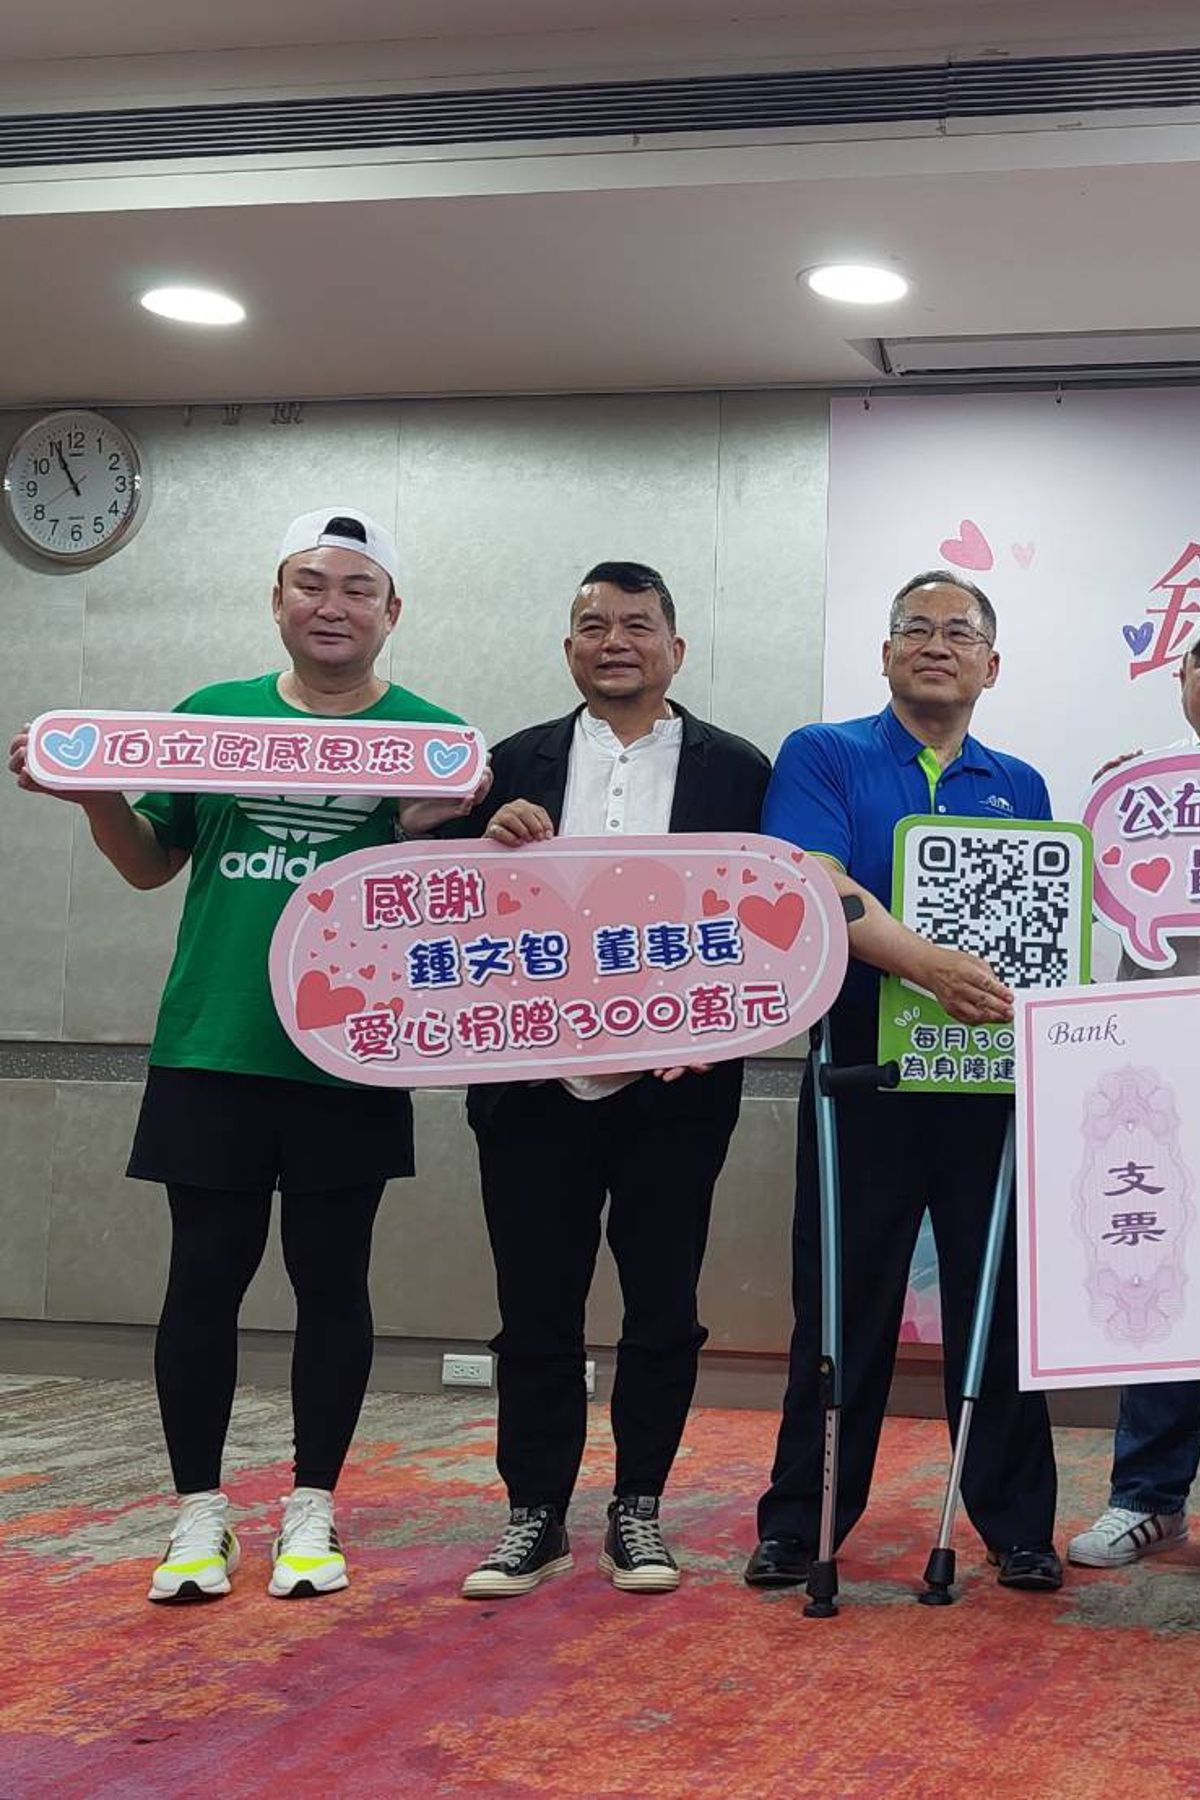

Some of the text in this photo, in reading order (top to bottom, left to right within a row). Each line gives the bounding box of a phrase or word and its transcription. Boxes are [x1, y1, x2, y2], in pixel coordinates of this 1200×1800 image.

[67, 431, 85, 449] 12
[96, 437, 103, 455] 1
[33, 458, 50, 475] 10
[108, 453, 120, 471] 2
[26, 480, 38, 498] 9
[114, 475, 127, 493] 3
[33, 504, 45, 521] 8
[108, 500, 120, 517] 4
[49, 519, 60, 536] 7
[71, 524, 82, 542] 6
[93, 516, 105, 534] 5
[105, 731, 414, 774] 伯立歐感恩您
[219, 844, 317, 884] adid
[363, 871, 485, 927] 感謝
[408, 917, 741, 988] 鍾文智 董事長
[345, 982, 789, 1060] 愛心捐贈300萬元
[1047, 1013, 1126, 1046] Bank
